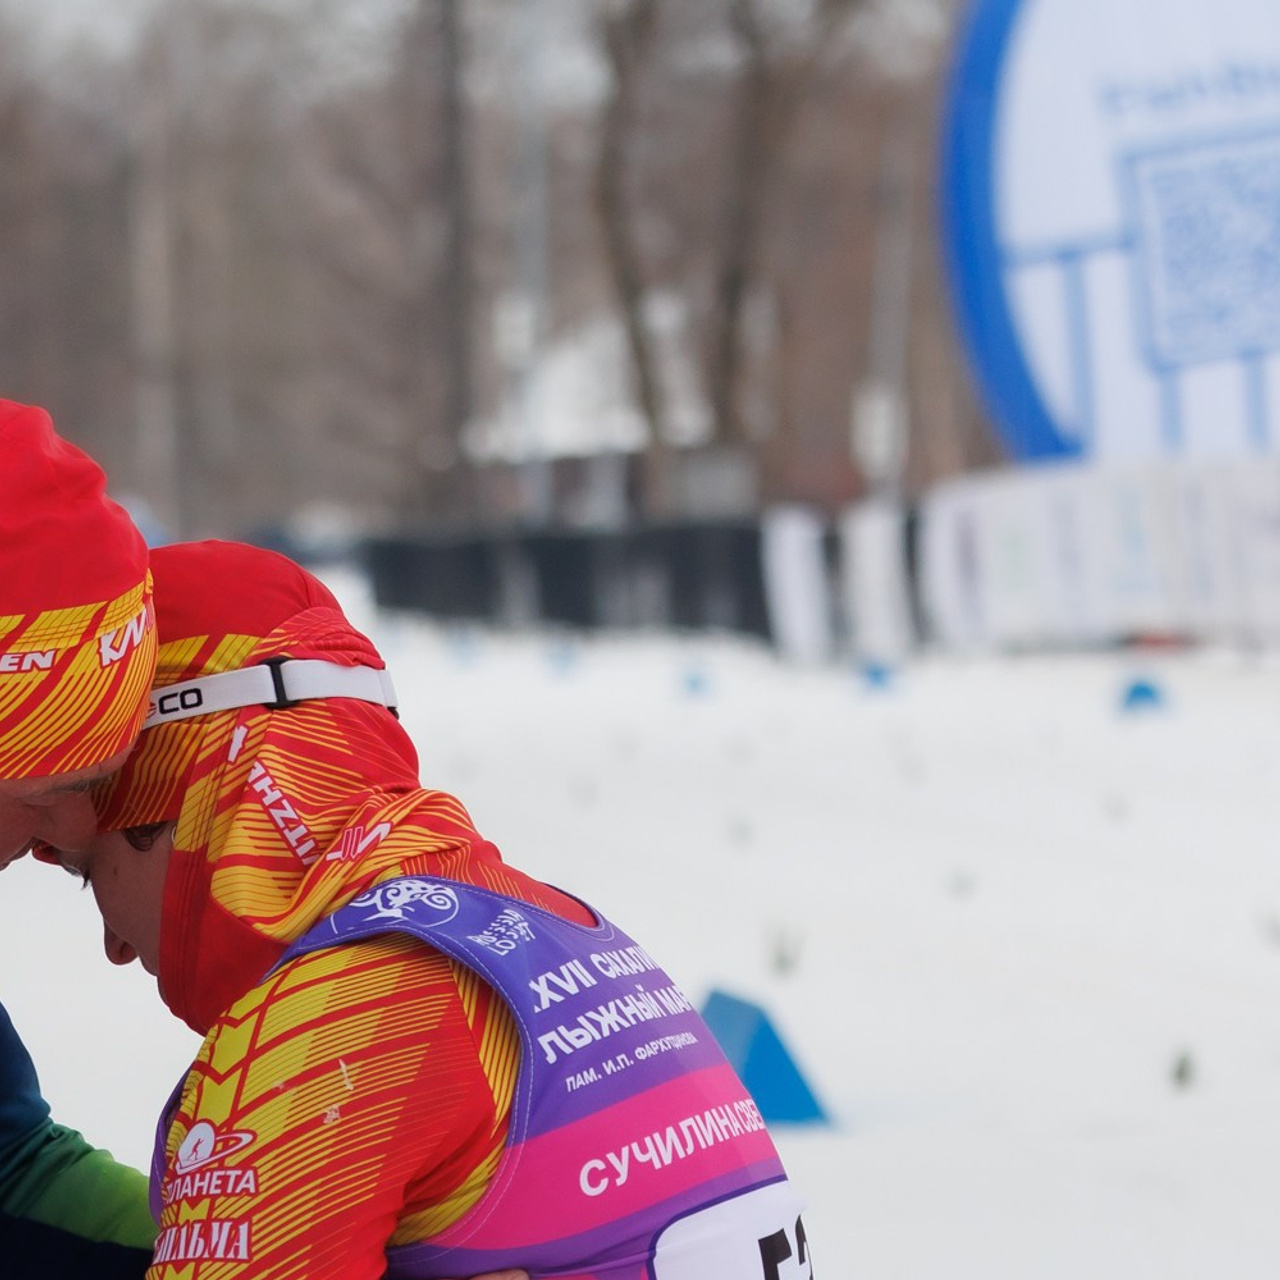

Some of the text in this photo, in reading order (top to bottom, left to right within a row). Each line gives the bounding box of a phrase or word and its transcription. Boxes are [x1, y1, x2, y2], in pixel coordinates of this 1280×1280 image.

[528, 959, 598, 1014] XVII
[537, 985, 666, 1064] ЛЫЖНЫЙ
[566, 1066, 602, 1092] ПАМ.
[603, 1053, 635, 1076] И.П.
[579, 1104, 745, 1197] СУЧИЛИНА
